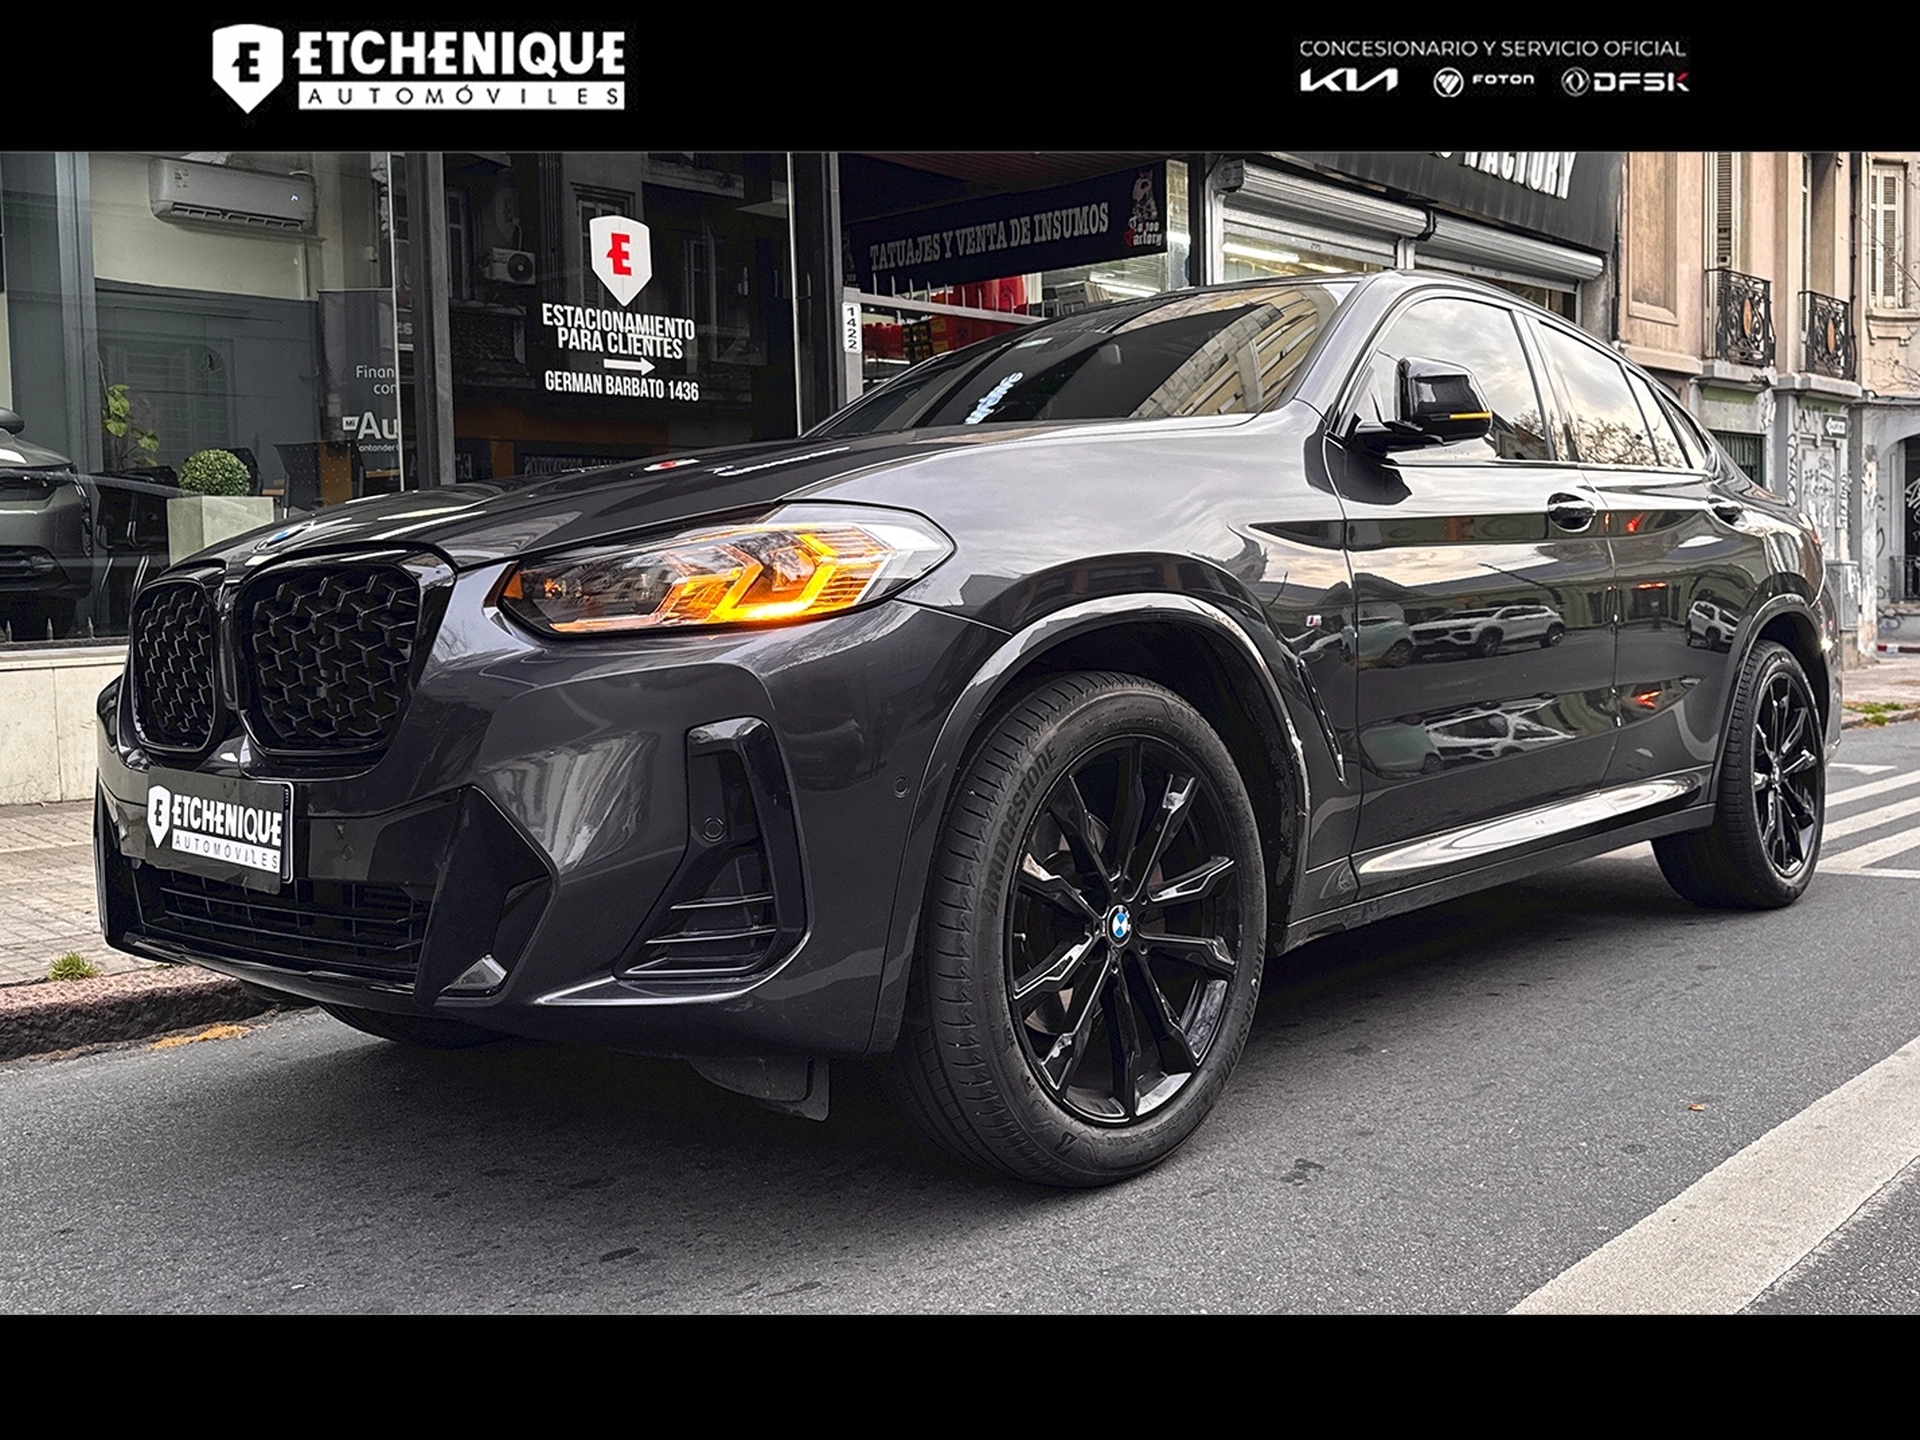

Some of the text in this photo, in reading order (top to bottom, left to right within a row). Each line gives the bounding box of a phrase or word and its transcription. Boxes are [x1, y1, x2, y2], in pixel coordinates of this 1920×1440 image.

[870, 202, 1109, 272] TATUAJES Y VENTA DE INSUMOS
[542, 303, 696, 341] ESTACIONAMIENTO
[846, 307, 858, 350] 1422
[558, 326, 684, 360] PARA CLIENTES
[545, 371, 699, 402] GERMAN BARBATO 1436
[172, 794, 283, 847] ETCHENIQUE
